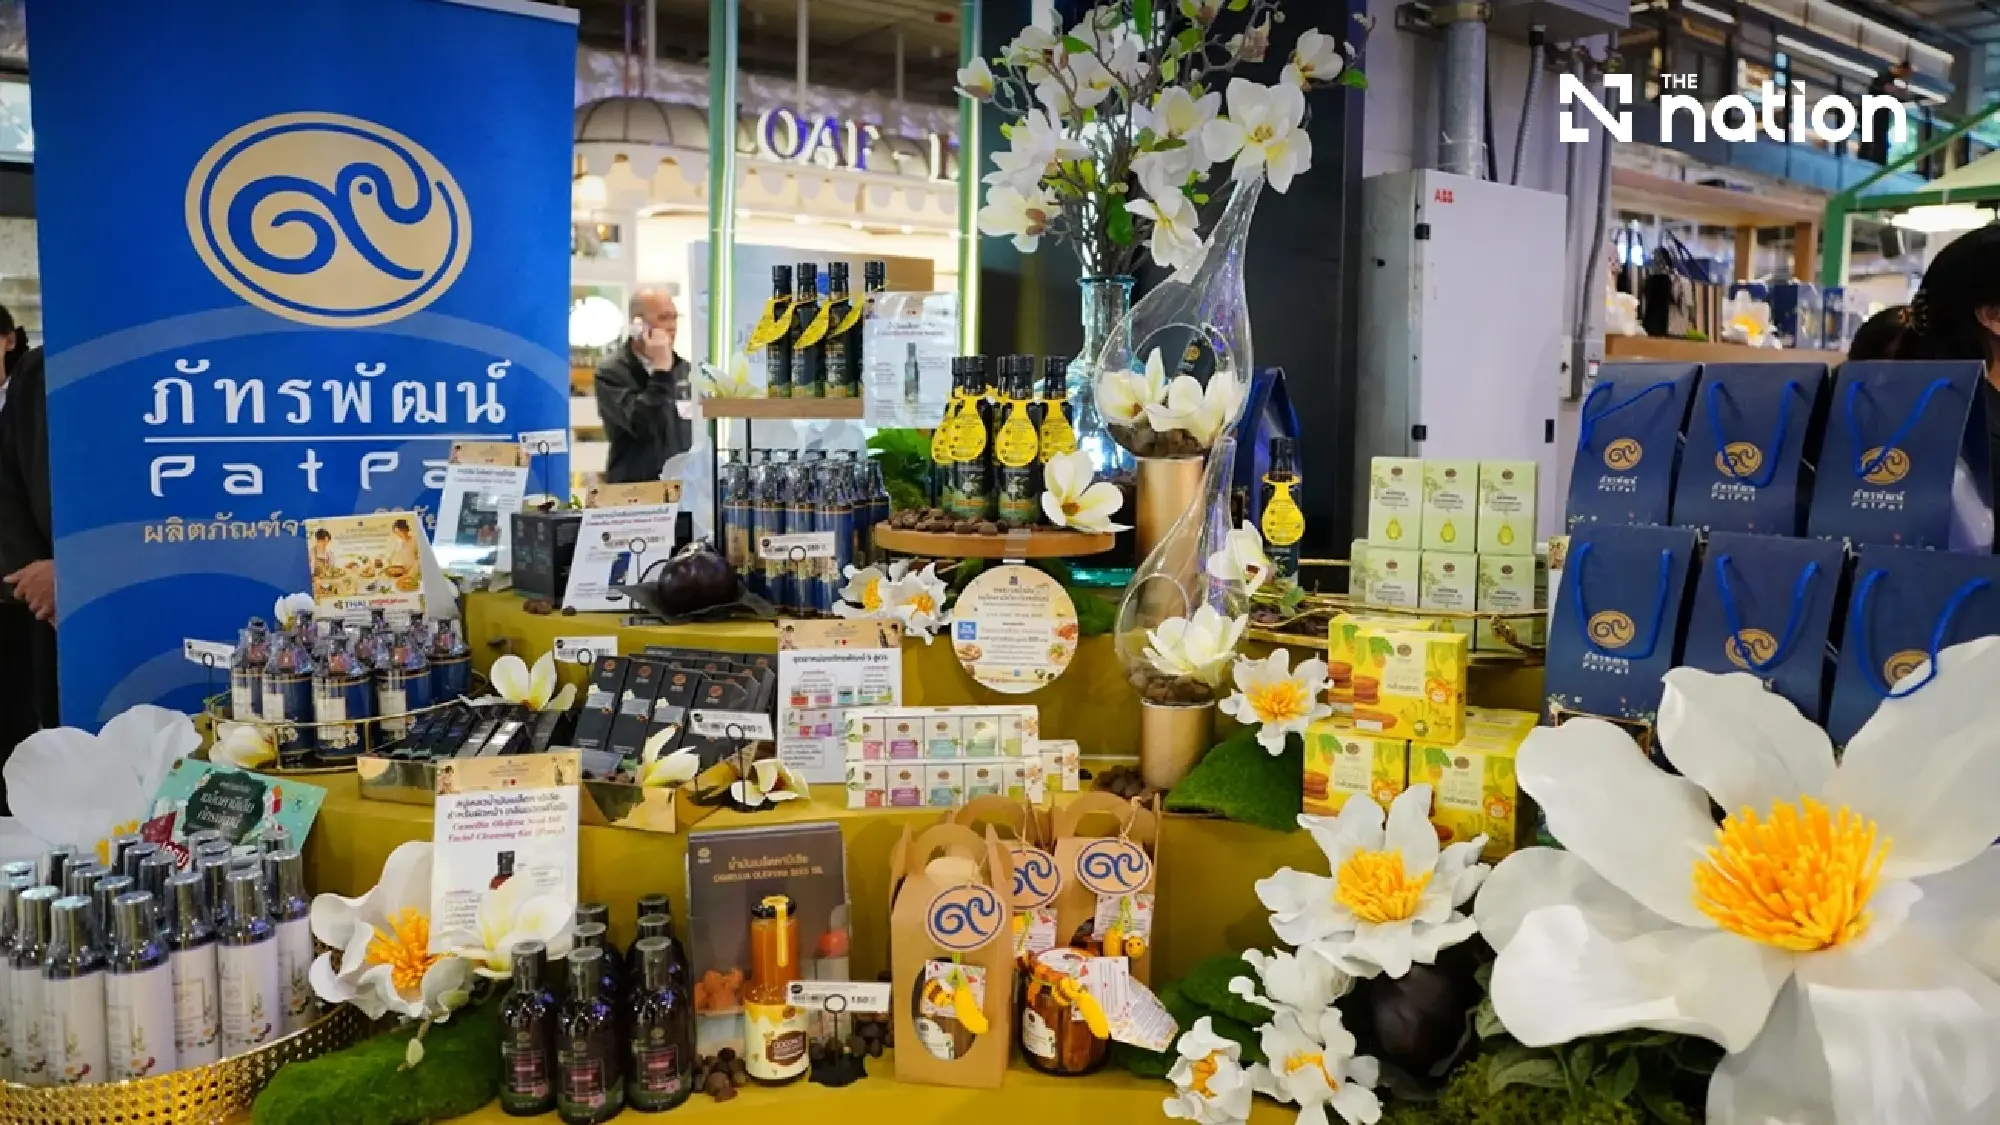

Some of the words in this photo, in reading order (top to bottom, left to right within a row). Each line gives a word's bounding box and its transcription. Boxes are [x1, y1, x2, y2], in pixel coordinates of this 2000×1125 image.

[757, 106, 880, 171] OAF
[143, 359, 511, 425] ภัทรพัฒน์
[150, 448, 447, 497] PatPa
[144, 510, 311, 543] ผลิตภัณฑ์จา
